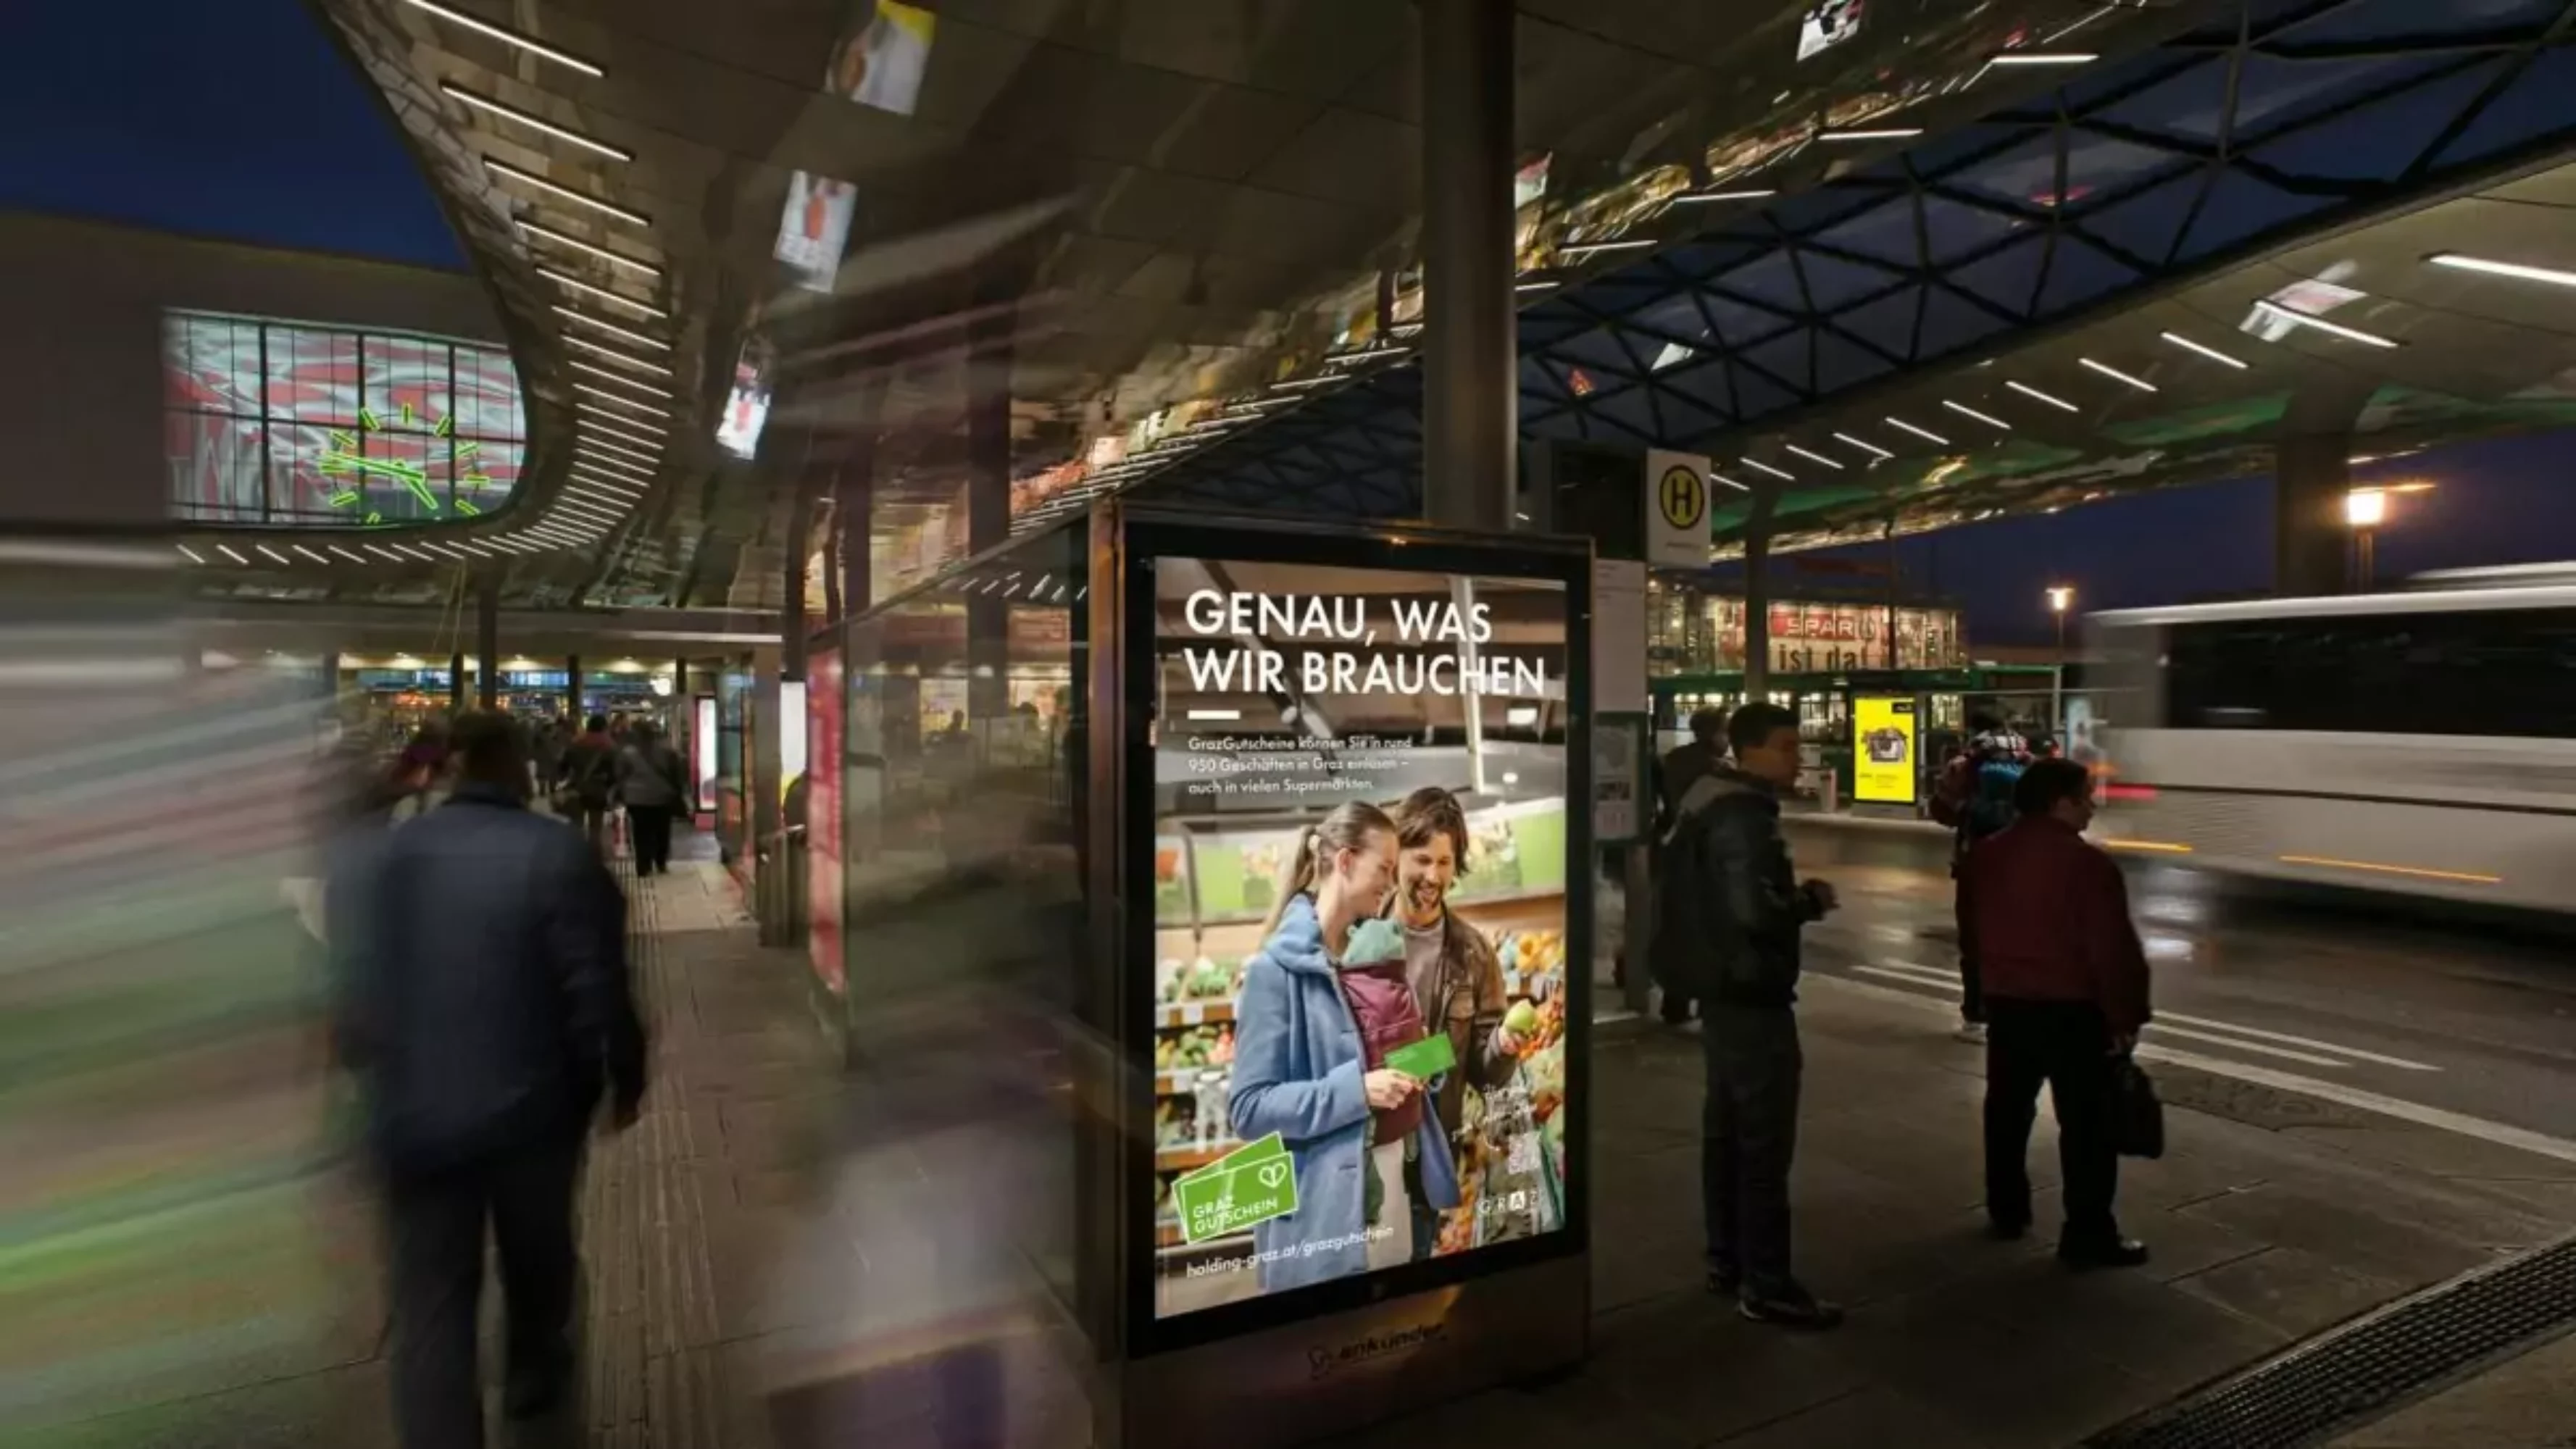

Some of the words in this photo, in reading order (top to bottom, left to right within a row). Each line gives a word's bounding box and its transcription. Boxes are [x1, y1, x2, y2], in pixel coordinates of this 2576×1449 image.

[1672, 477, 1693, 517] H
[1185, 589, 1376, 647] GENAU,
[1391, 599, 1492, 644] WAS
[1787, 617, 1854, 637] SPAR
[1778, 643, 1814, 671] ist
[1185, 648, 1286, 693] WIR
[1304, 653, 1545, 696] BRAUCHEN
[1188, 735, 1296, 751] GrazGutscheine
[1298, 735, 1346, 750] können
[1384, 735, 1412, 748] rund
[1188, 758, 1217, 772] 950
[1313, 756, 1343, 769] Graz
[1188, 777, 1222, 794] auch
[1225, 780, 1237, 793] in
[1240, 777, 1280, 793] vielen
[1193, 1195, 1235, 1219] GRAZ
[1196, 1197, 1278, 1234] GUTSCHEIN
[1186, 1227, 1394, 1279] holding-graz.at/grazgutschein
